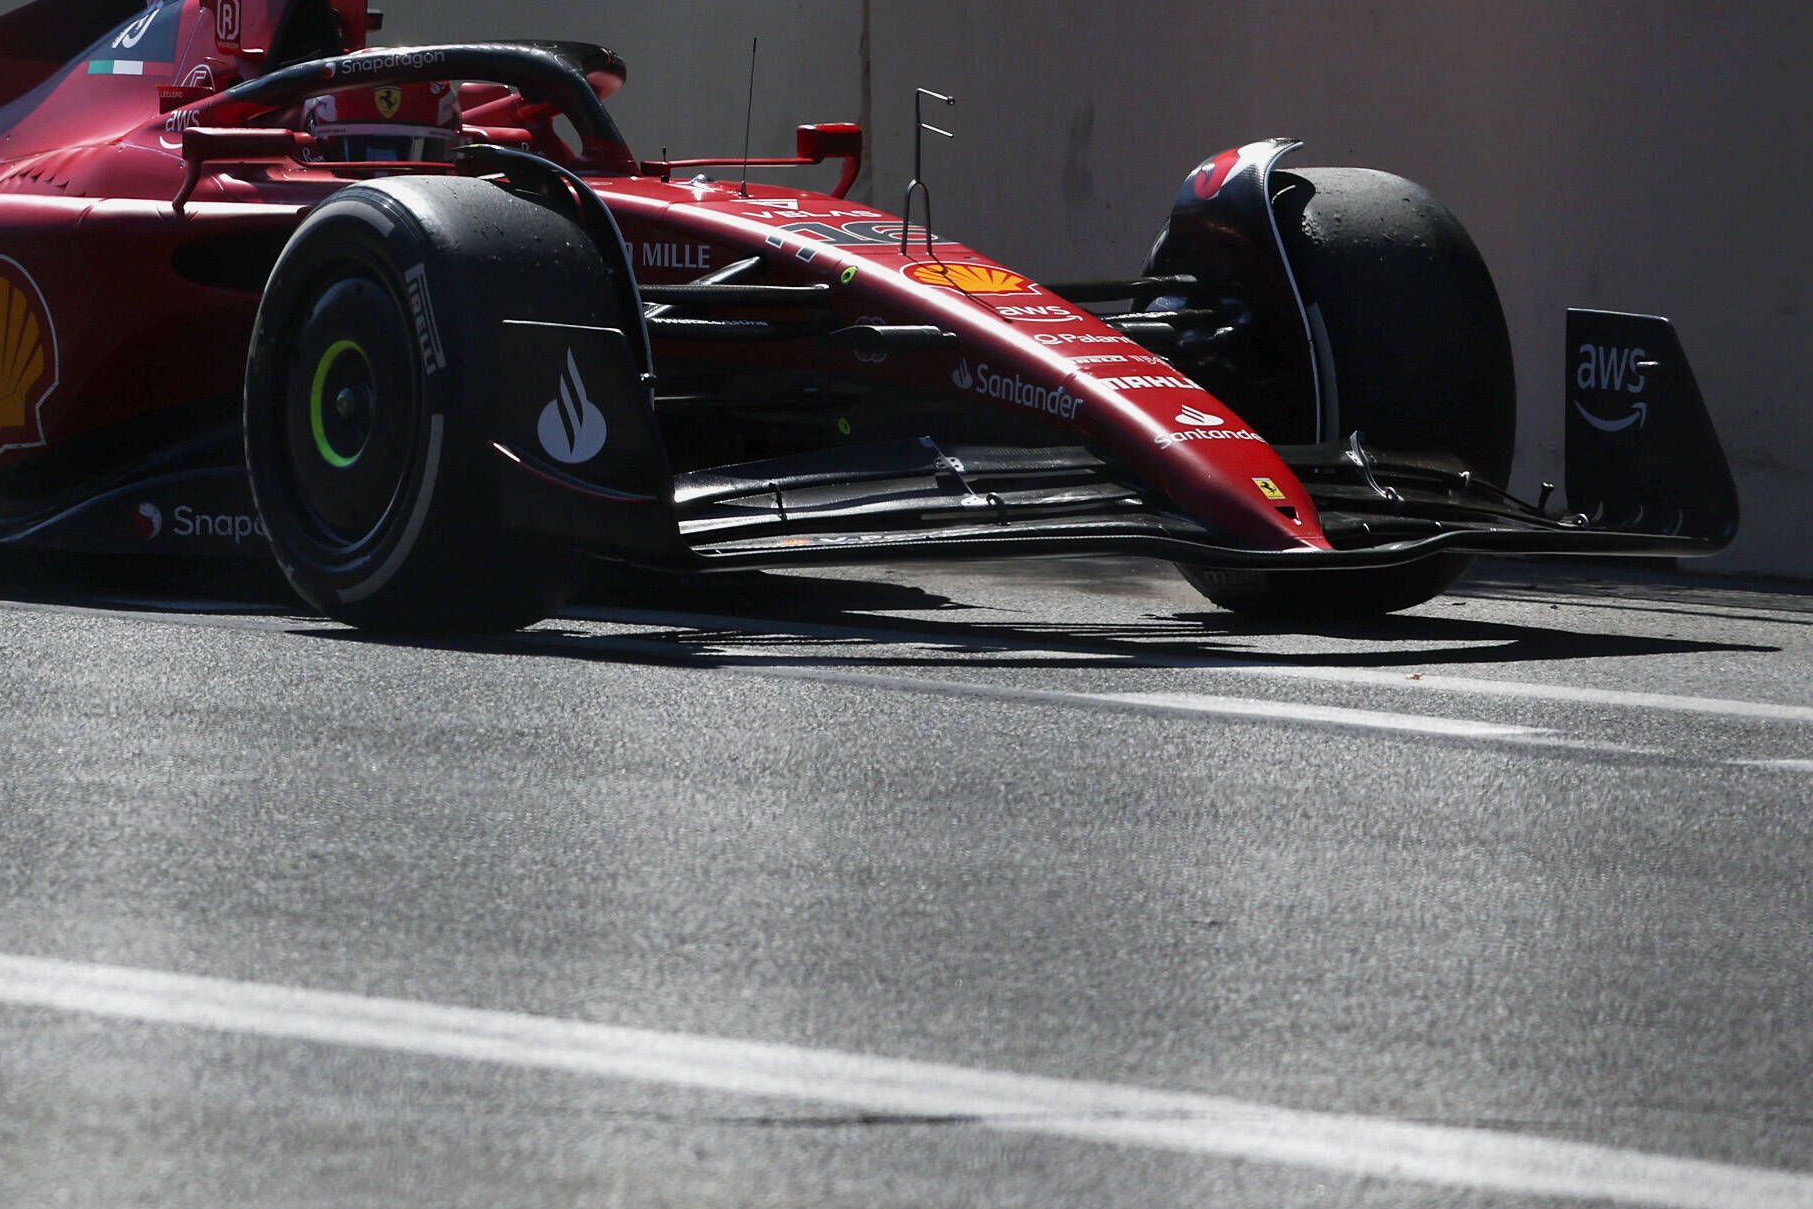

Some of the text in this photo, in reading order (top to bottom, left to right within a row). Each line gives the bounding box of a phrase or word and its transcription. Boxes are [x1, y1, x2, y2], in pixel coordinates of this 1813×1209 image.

[341, 51, 446, 74] Snapdragon
[643, 243, 711, 269] MILLE
[404, 262, 447, 377] PIRELLI
[995, 305, 1067, 317] aws
[1576, 343, 1647, 393] aws
[975, 363, 1084, 421] Santander
[1154, 428, 1269, 450] Santande
